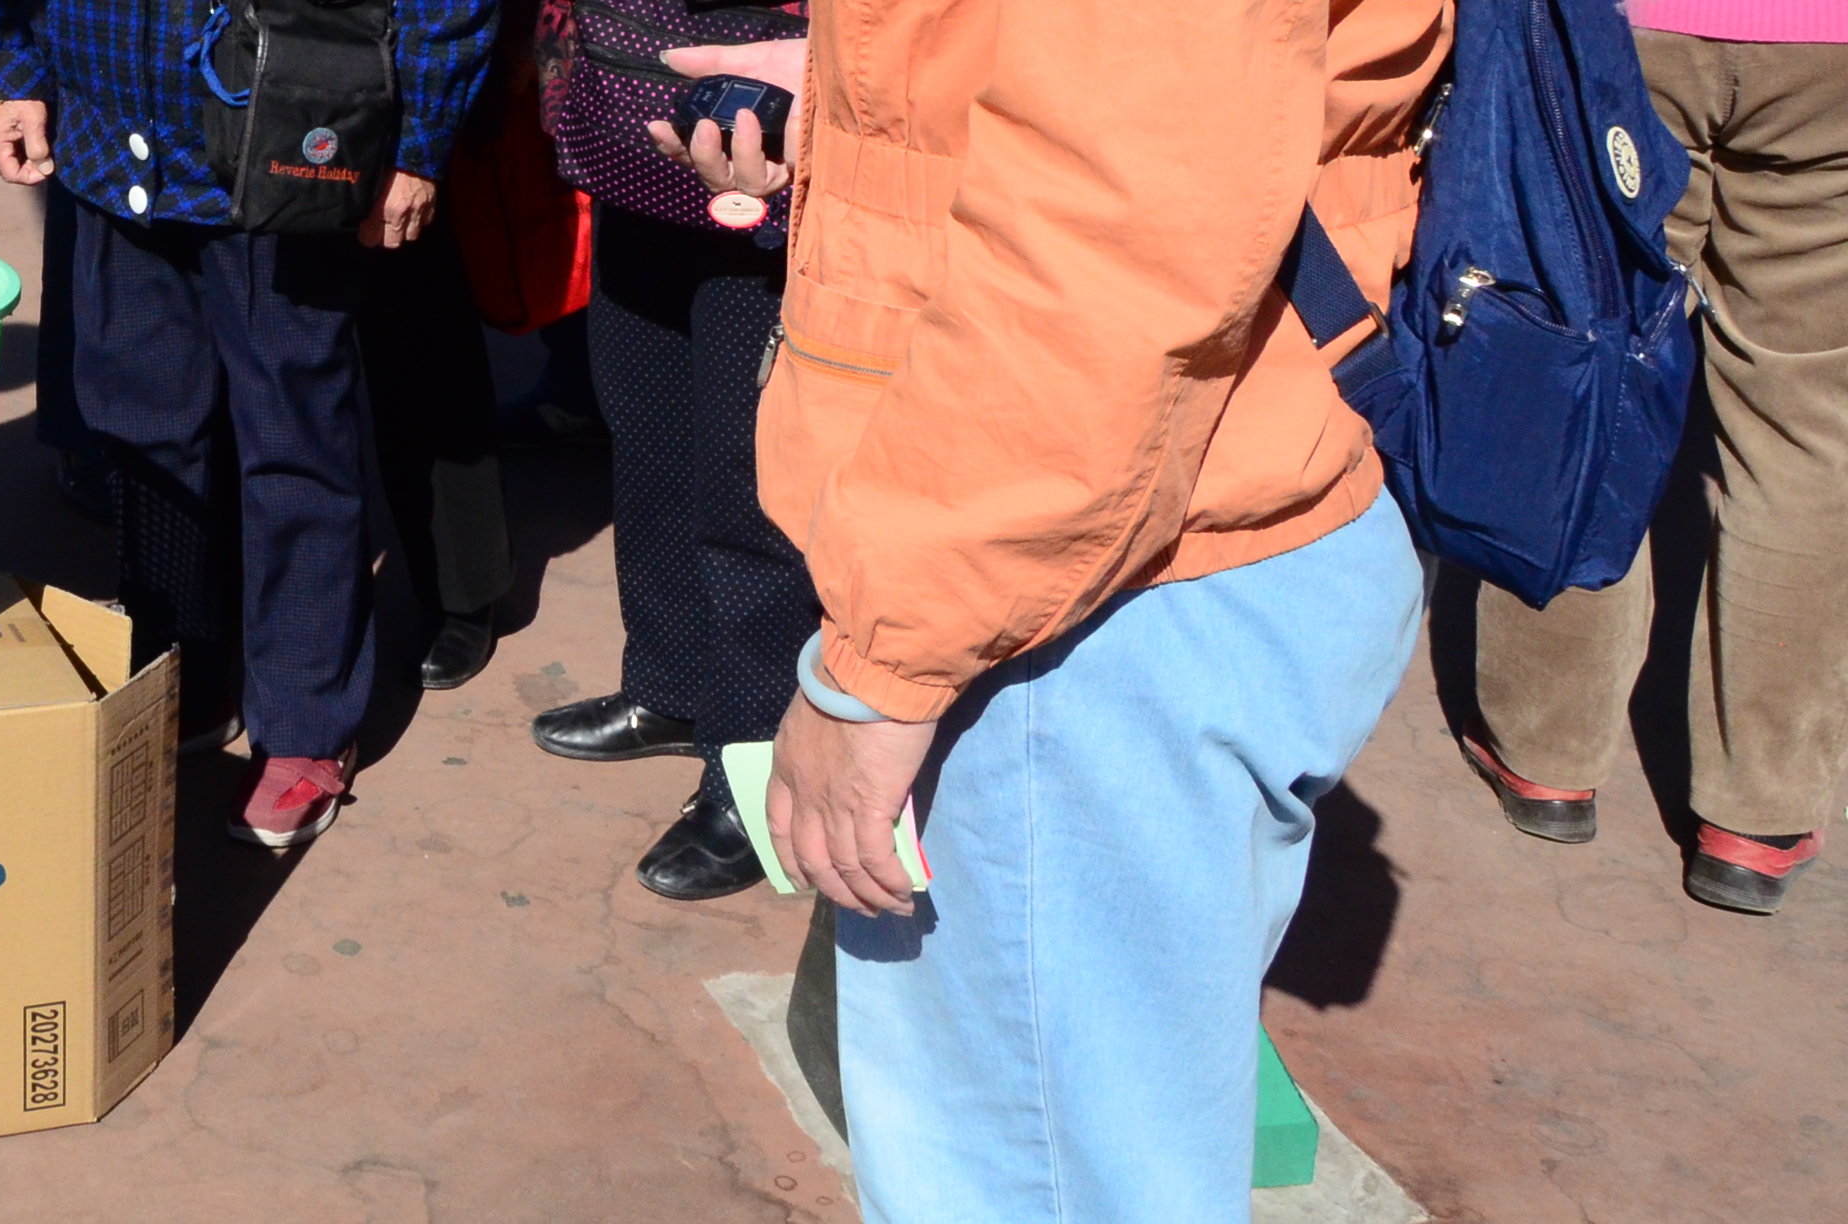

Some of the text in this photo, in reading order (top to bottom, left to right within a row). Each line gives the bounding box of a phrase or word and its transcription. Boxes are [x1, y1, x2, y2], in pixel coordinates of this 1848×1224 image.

[269, 160, 360, 184] Reverie Holiday
[30, 1008, 60, 1105] 20273628
